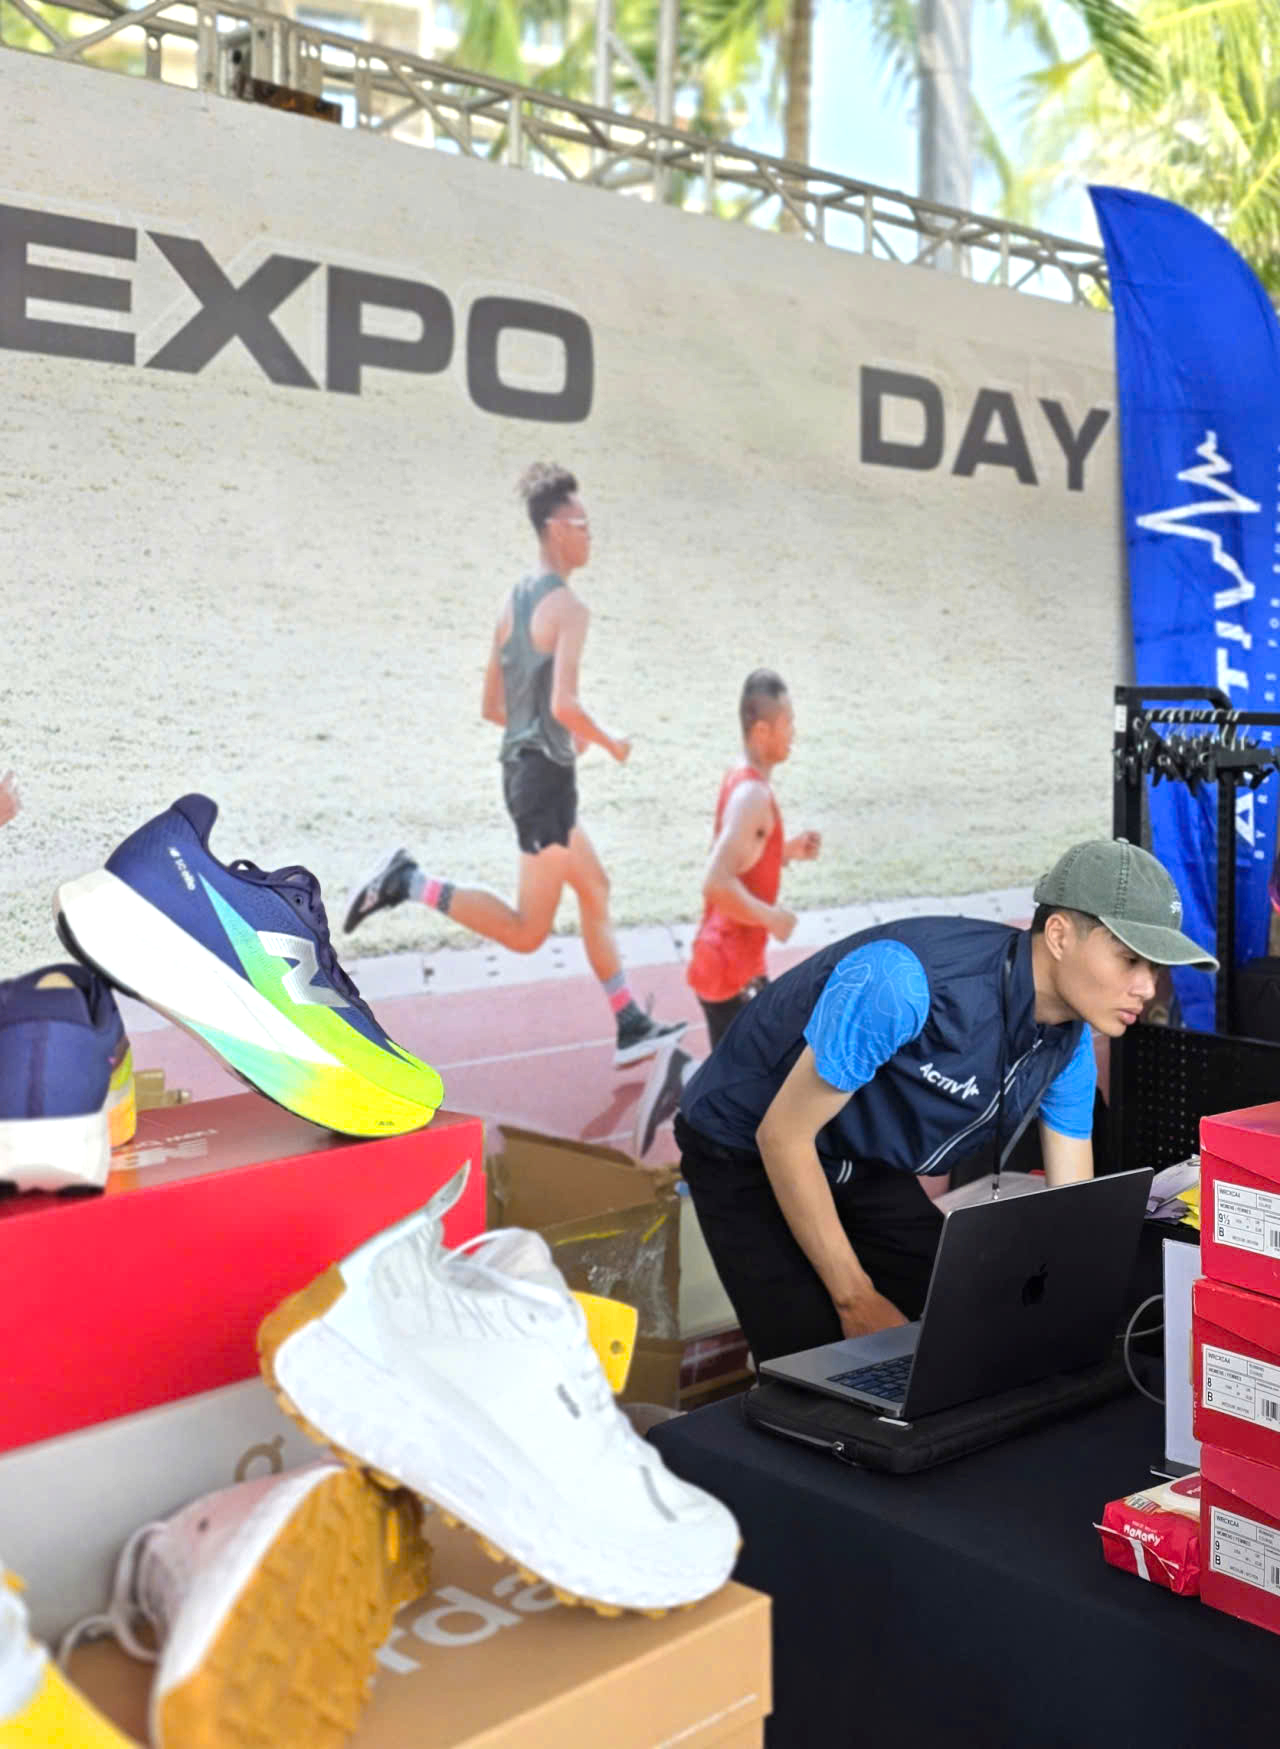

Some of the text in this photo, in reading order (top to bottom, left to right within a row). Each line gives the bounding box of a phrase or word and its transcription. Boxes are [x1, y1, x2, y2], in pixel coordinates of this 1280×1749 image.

[0, 203, 594, 423] EXPO
[861, 365, 1110, 492] DAY
[1218, 1226, 1224, 1237] B
[1207, 1377, 1211, 1387] 8
[1207, 1391, 1212, 1401] B
[1215, 1540, 1219, 1550] 9
[1215, 1554, 1220, 1565] B
